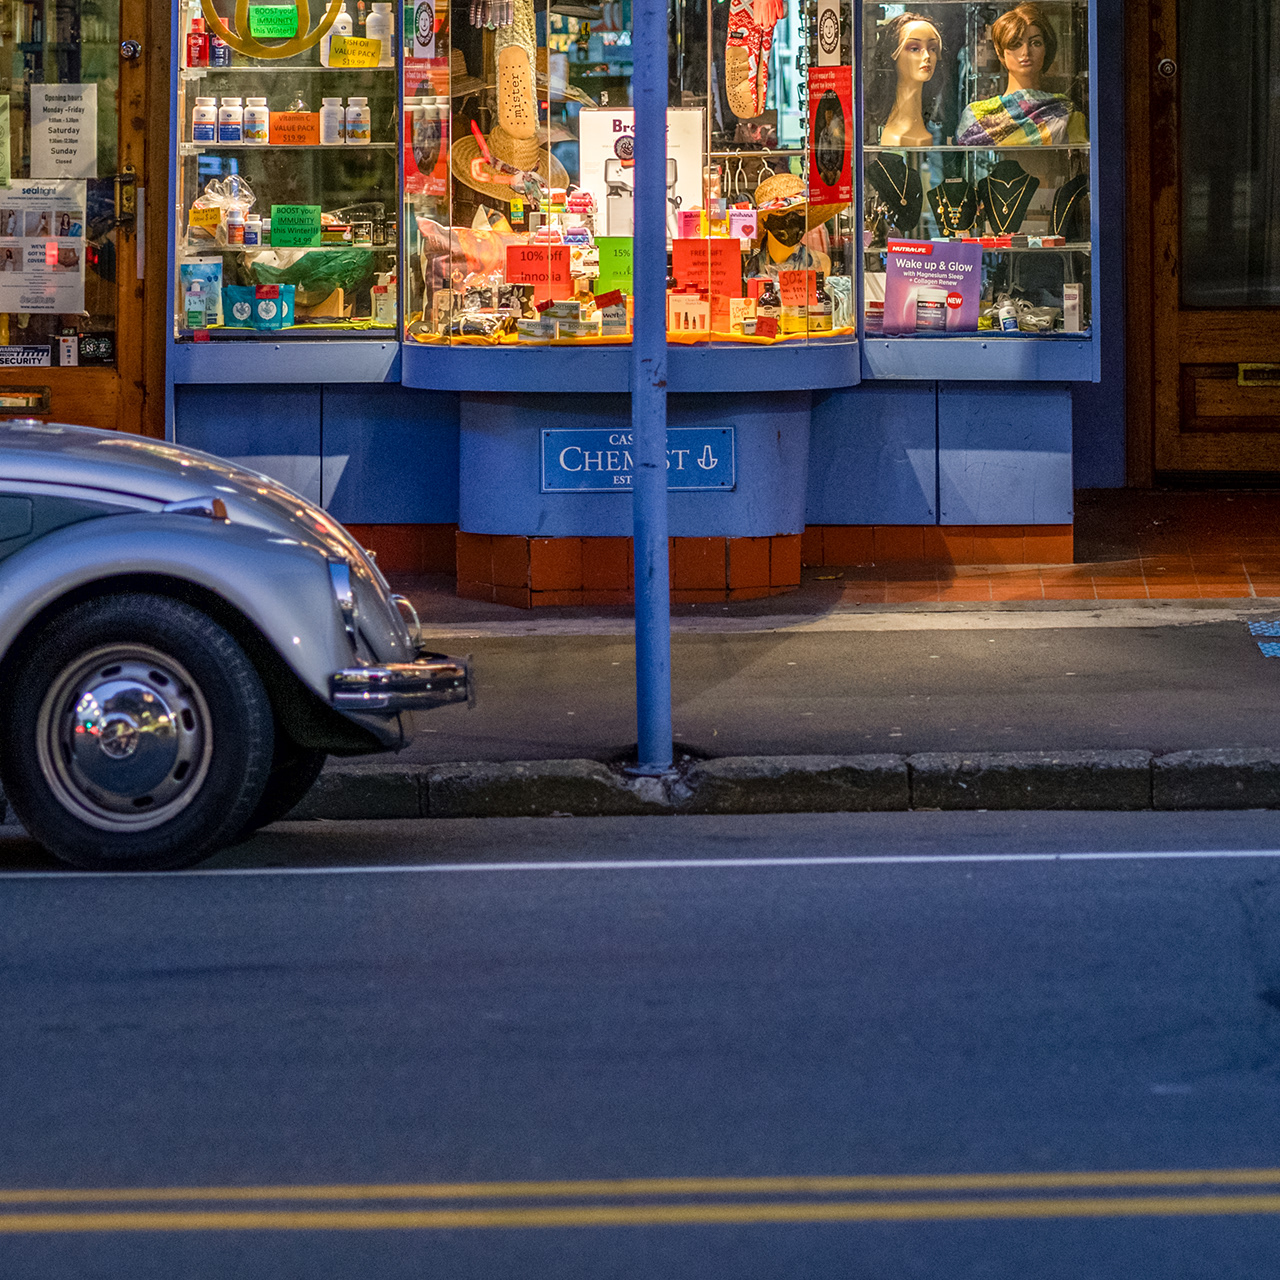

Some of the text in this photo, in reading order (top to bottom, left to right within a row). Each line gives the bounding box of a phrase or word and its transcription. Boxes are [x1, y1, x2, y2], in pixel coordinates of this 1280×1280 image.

[334, 48, 356, 56] VALUE
[342, 58, 366, 66] $19.99
[44, 94, 66, 102] Opening
[512, 73, 522, 119] mister
[48, 127, 80, 135] Saturday
[283, 134, 306, 142] $19.99
[276, 207, 317, 216] BOOST your
[277, 217, 315, 225] IMMUNITY
[273, 227, 289, 235] this
[292, 236, 312, 245] $4.99
[520, 250, 563, 261] 10% off
[613, 249, 631, 257] 15%
[895, 258, 973, 272] Wake up & Glow
[916, 271, 948, 279] Magnesium
[914, 277, 938, 285] Collagen
